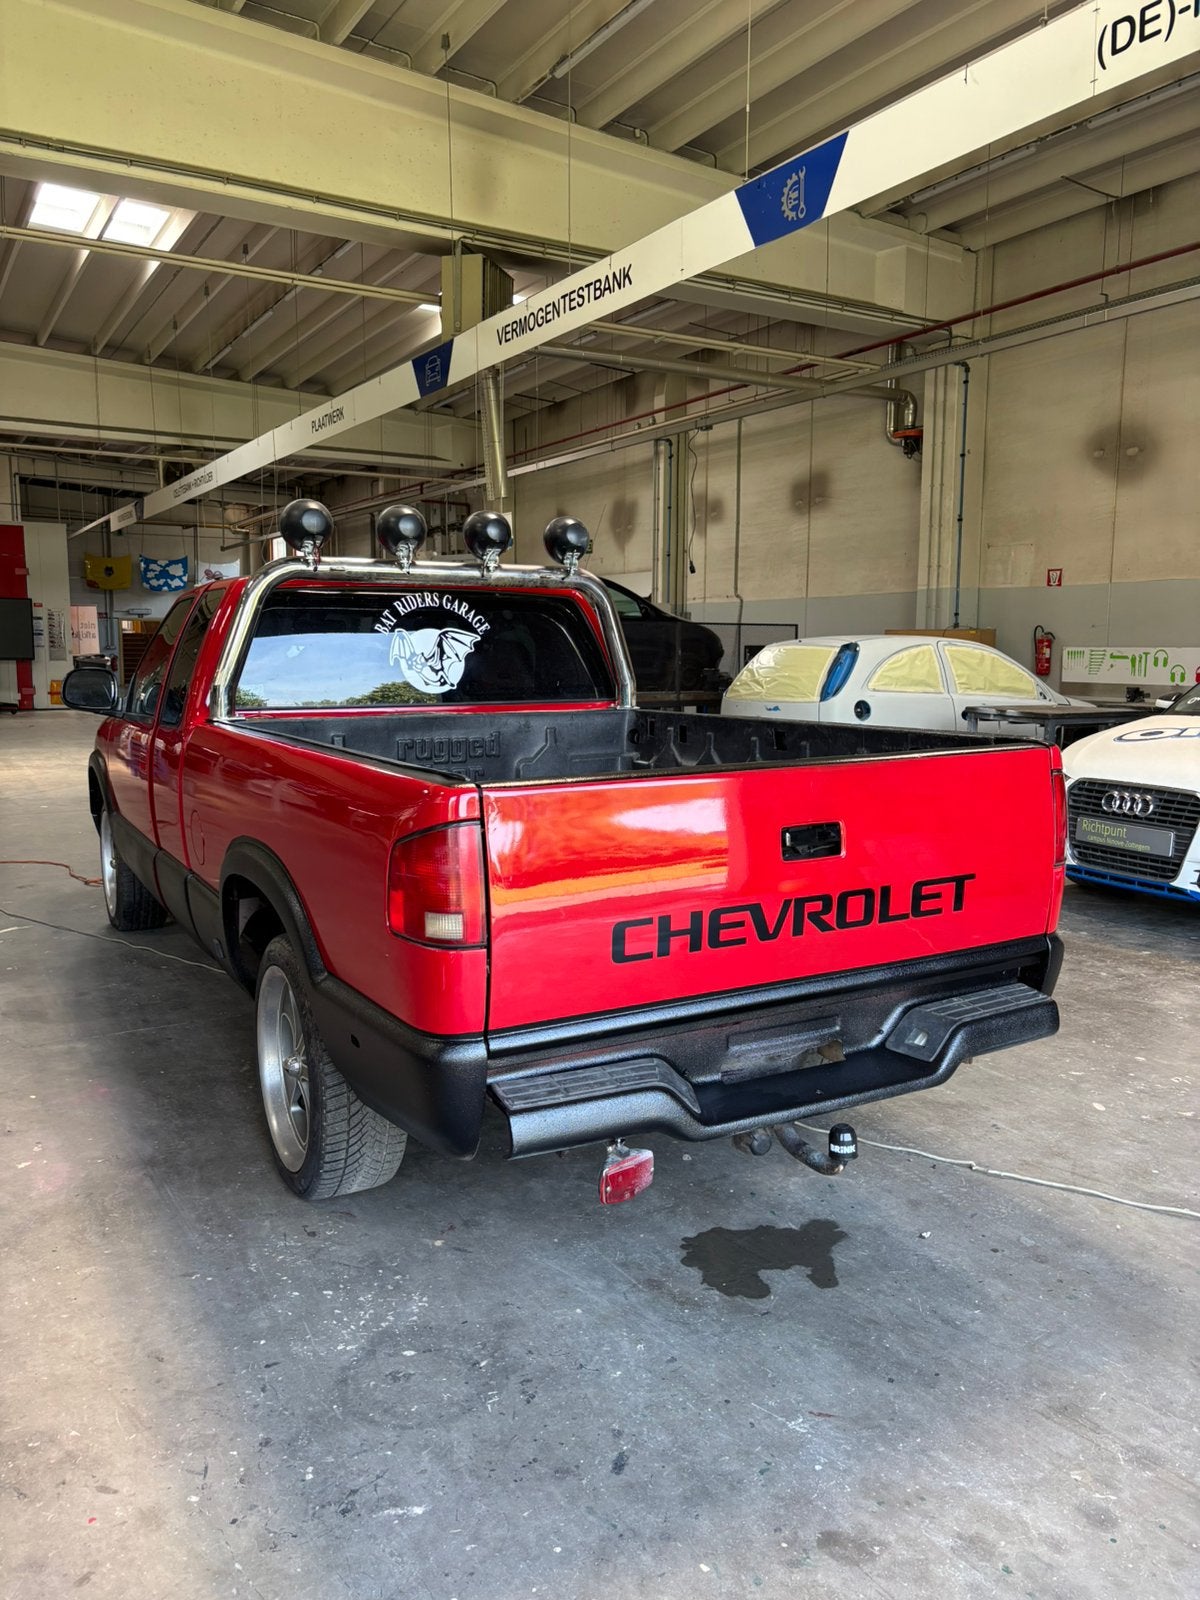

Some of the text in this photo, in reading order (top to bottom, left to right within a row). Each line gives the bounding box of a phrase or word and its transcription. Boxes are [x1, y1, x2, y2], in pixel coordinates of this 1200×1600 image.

[1097, 0, 1200, 70] (DE)-
[496, 263, 633, 346] VERMOGENTESTBANK
[311, 405, 345, 434] PLAATWERK
[374, 592, 491, 635] BAT RIDERS GARAGE
[396, 729, 501, 765] rugged
[1082, 819, 1127, 838] Richtpunt
[611, 873, 976, 964] CHEVROLET
